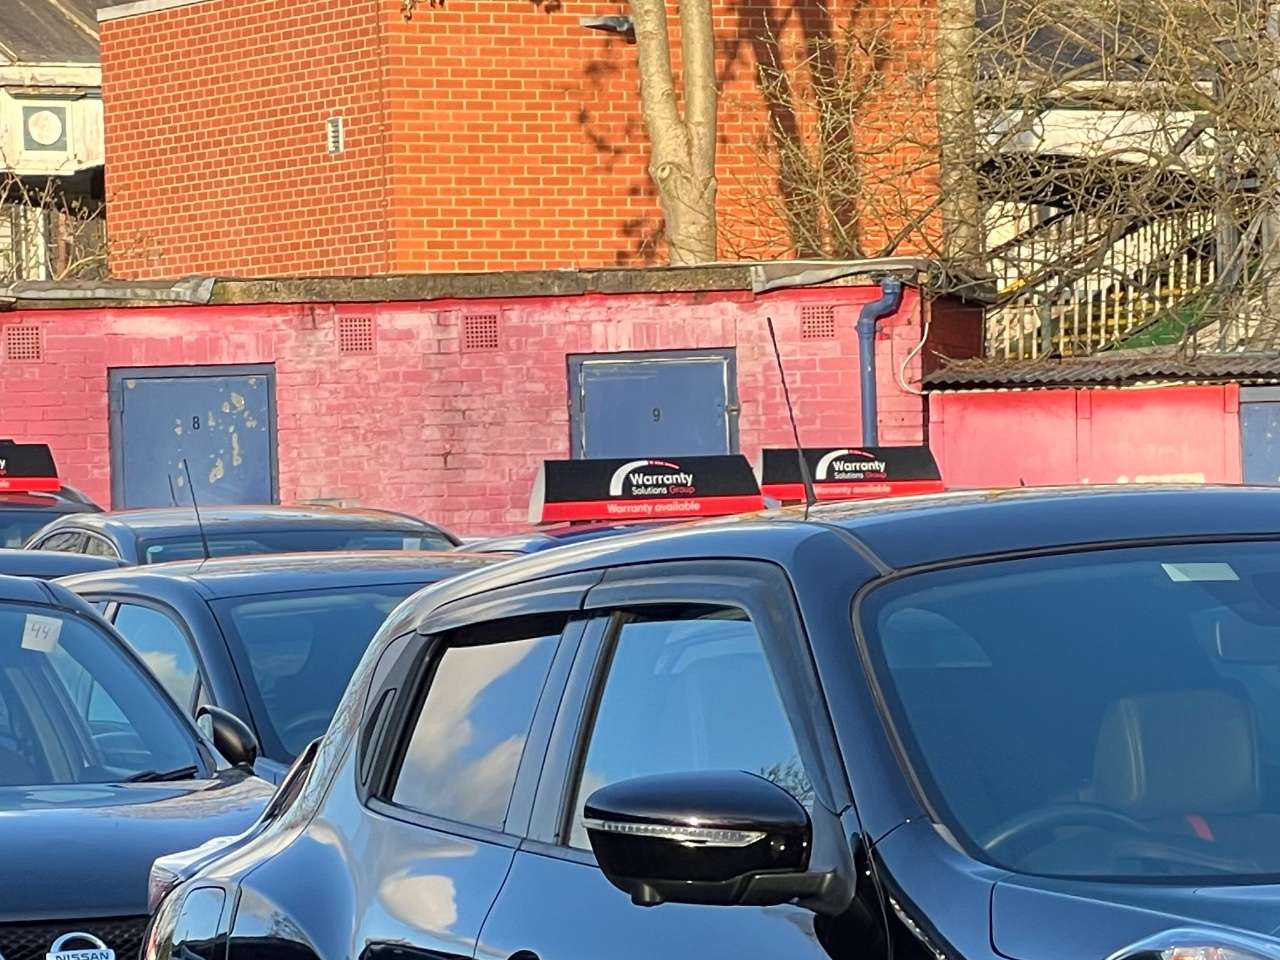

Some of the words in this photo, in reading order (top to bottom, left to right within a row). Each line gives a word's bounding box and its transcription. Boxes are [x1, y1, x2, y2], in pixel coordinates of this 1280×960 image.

[652, 407, 661, 423] 9
[192, 415, 201, 431] 8
[832, 460, 886, 473] Warranty
[629, 472, 693, 487] Warranty
[631, 486, 668, 496] Solutions
[669, 485, 696, 494] Group
[606, 503, 653, 515] Warranty
[654, 501, 701, 512] available
